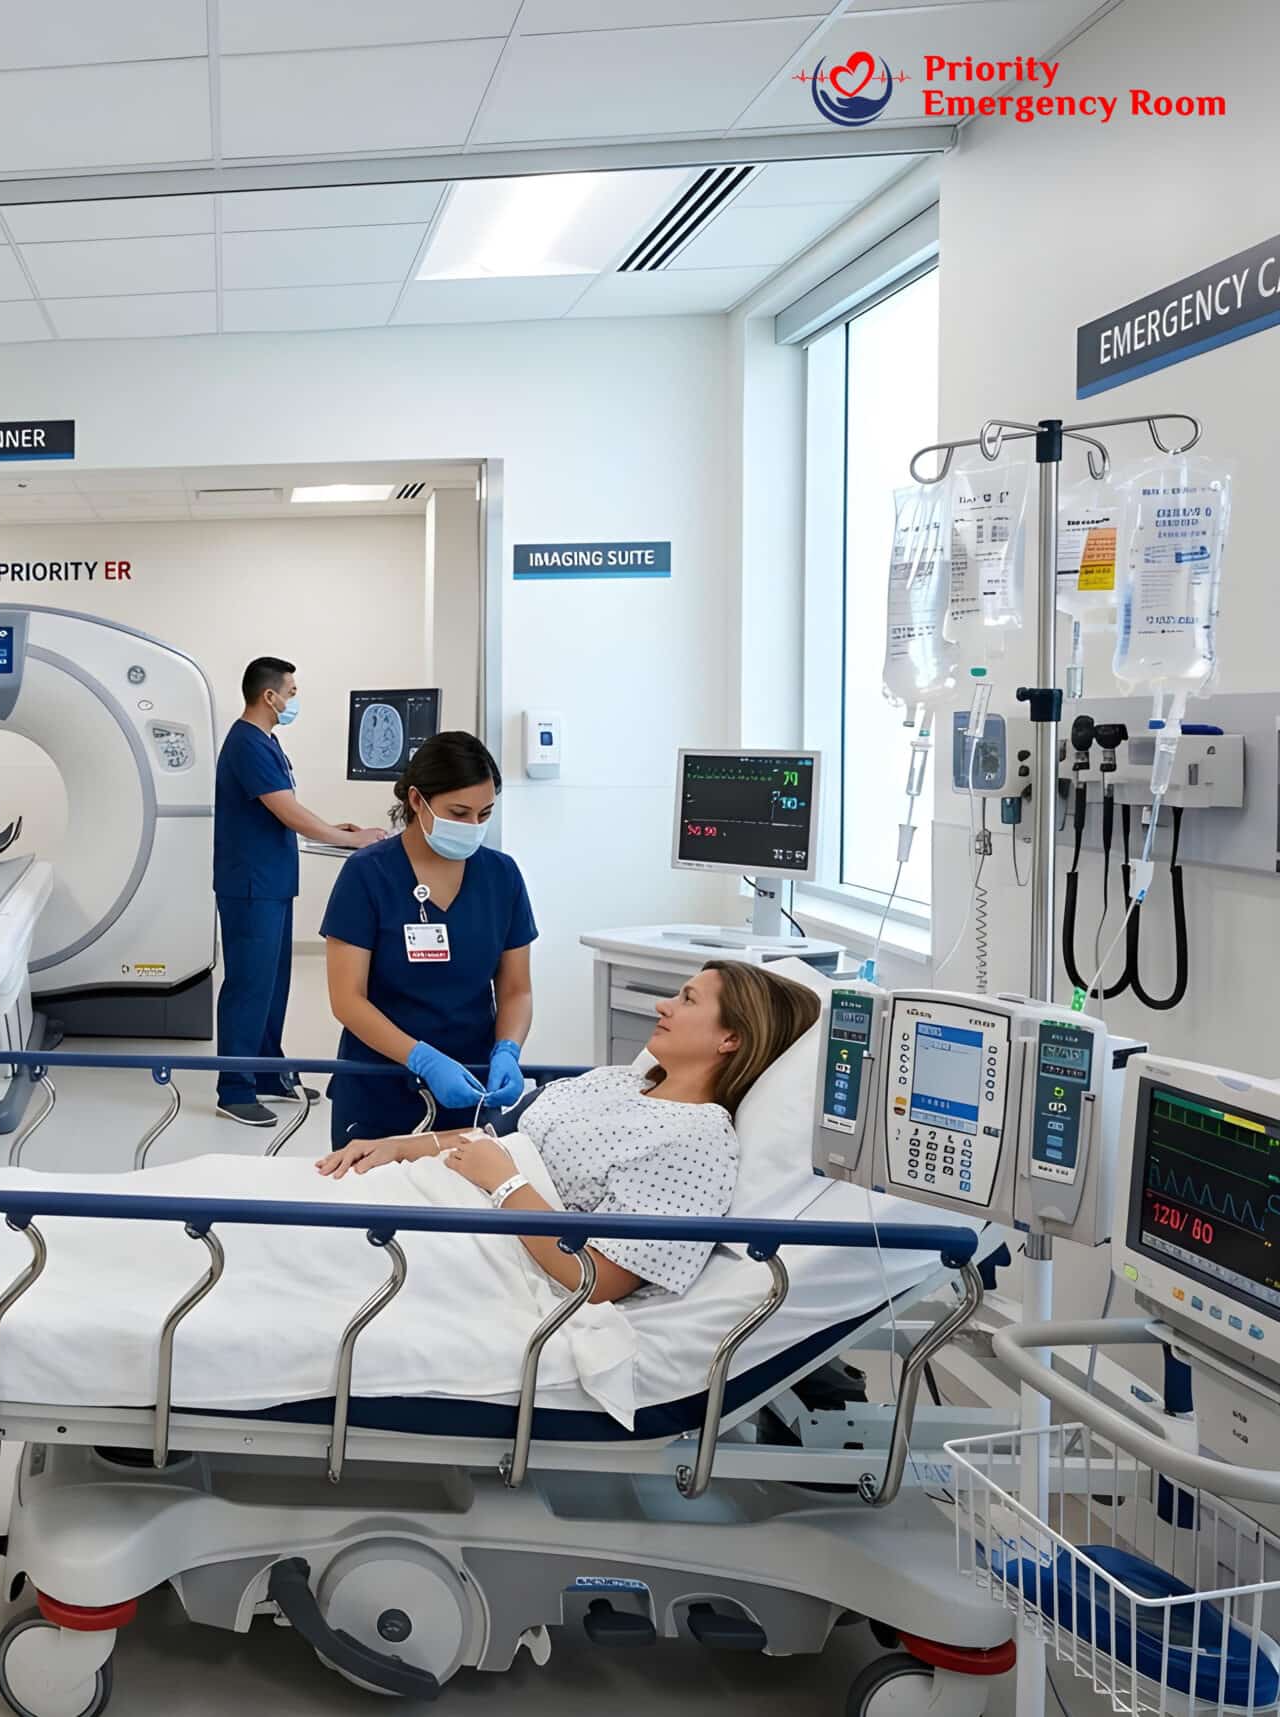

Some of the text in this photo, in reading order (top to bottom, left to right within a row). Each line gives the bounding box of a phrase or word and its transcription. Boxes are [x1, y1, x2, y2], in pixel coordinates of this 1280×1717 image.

[1100, 257, 1280, 364] EMERGENCY C
[529, 549, 655, 566] IMAGING SUITE
[105, 561, 131, 580] ER
